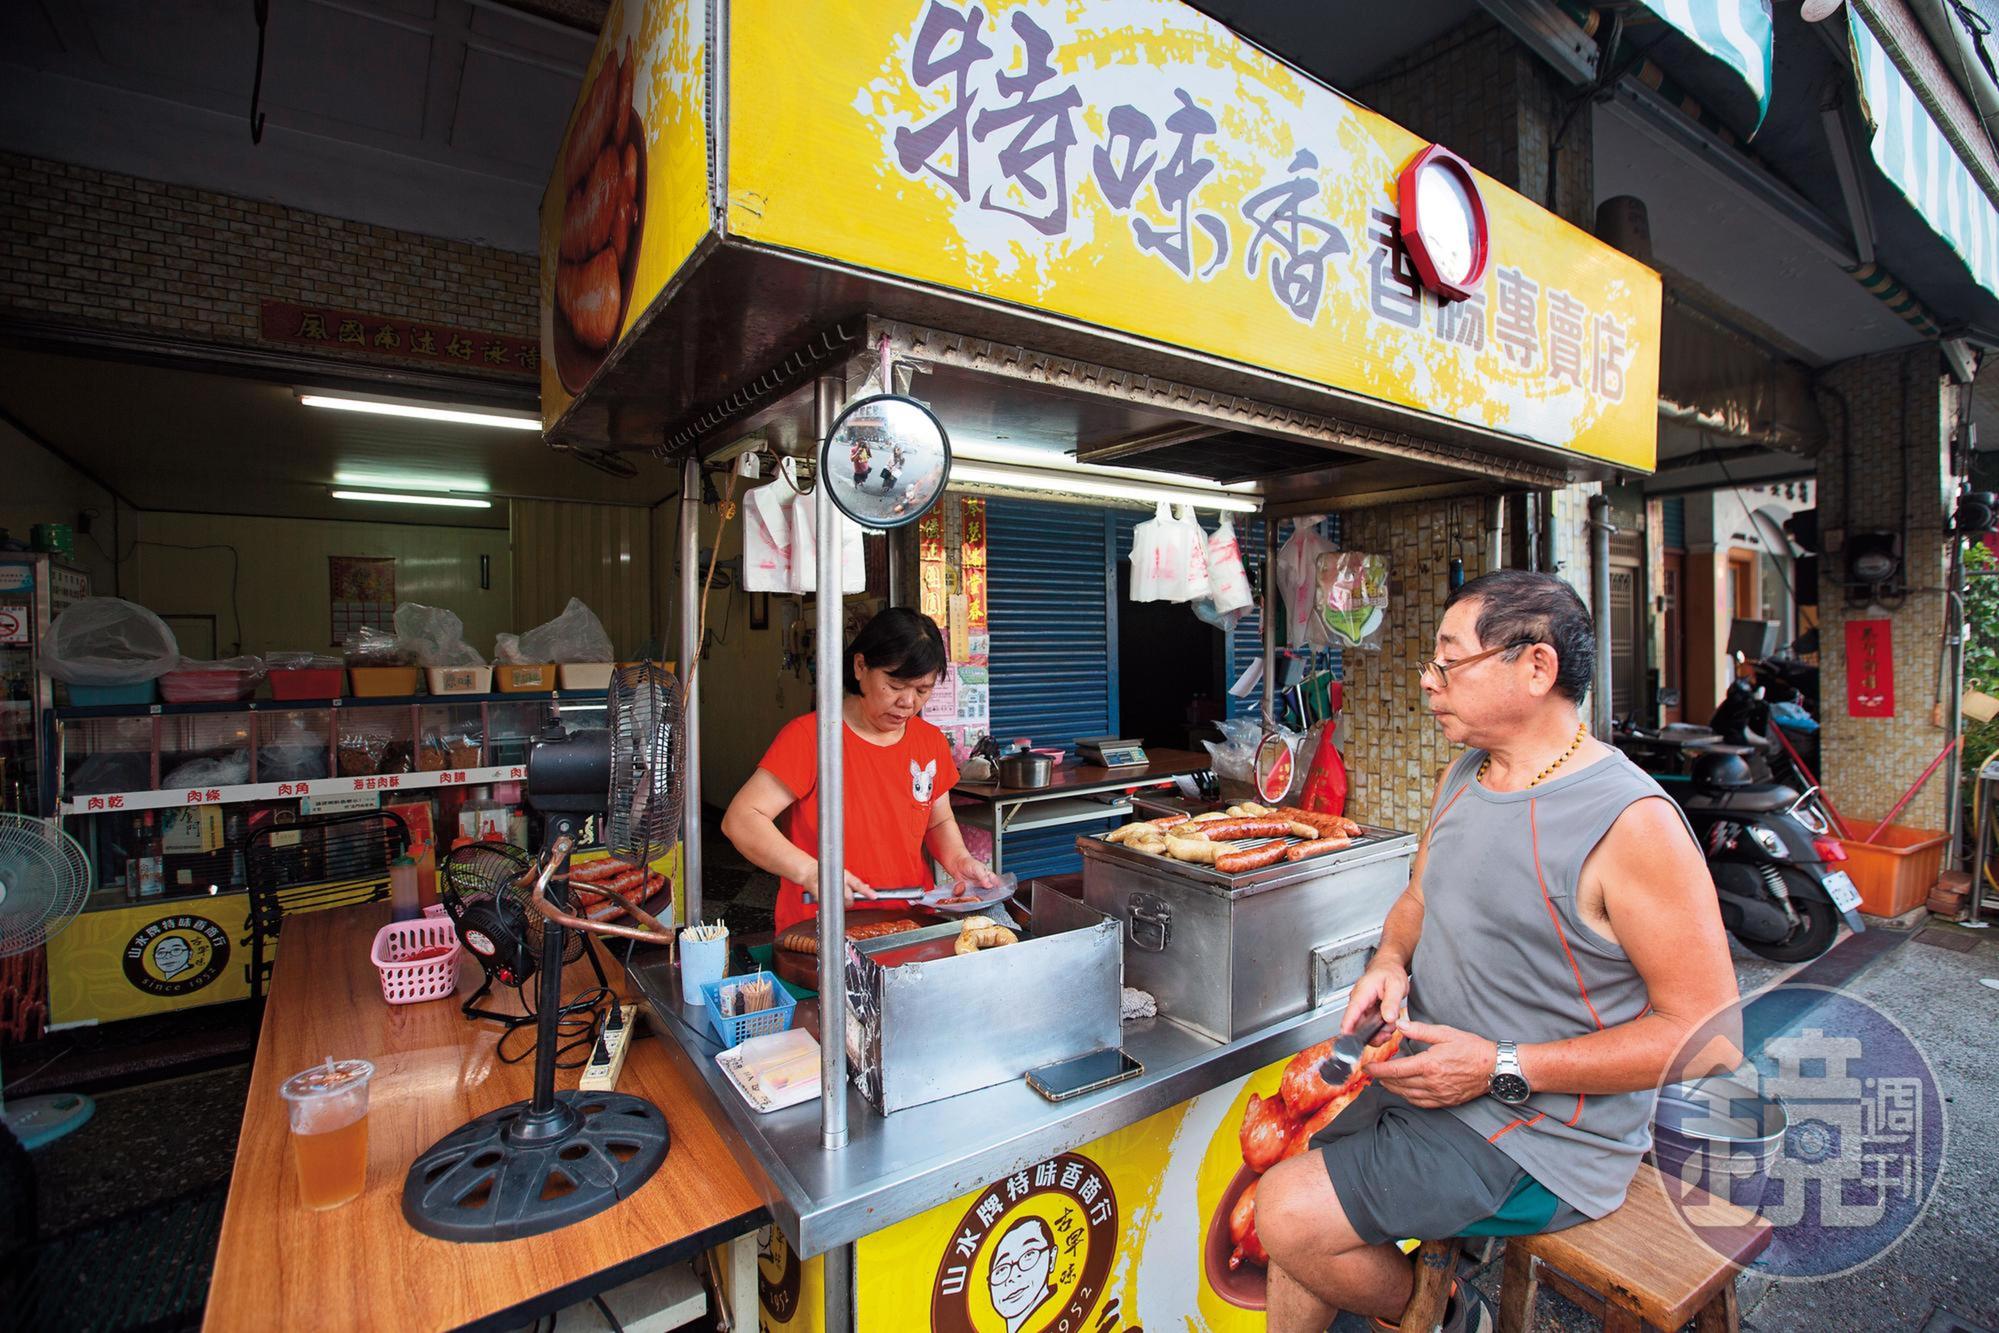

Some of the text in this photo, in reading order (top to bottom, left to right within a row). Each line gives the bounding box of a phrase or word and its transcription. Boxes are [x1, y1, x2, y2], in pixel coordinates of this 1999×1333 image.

[894, 0, 1351, 321] 特味香
[353, 773, 400, 791] 海苔肉酥
[511, 768, 528, 779] 肉
[187, 789, 222, 803] 肉條
[278, 783, 310, 796] 肉角
[88, 795, 124, 811] 肉乾
[128, 917, 227, 959] 山水牌特味香商行
[142, 967, 217, 992] since 1952
[941, 1160, 1113, 1296] 山水牌特味香商行
[1054, 1207, 1086, 1286] 古早味
[1050, 1287, 1093, 1333] 952
